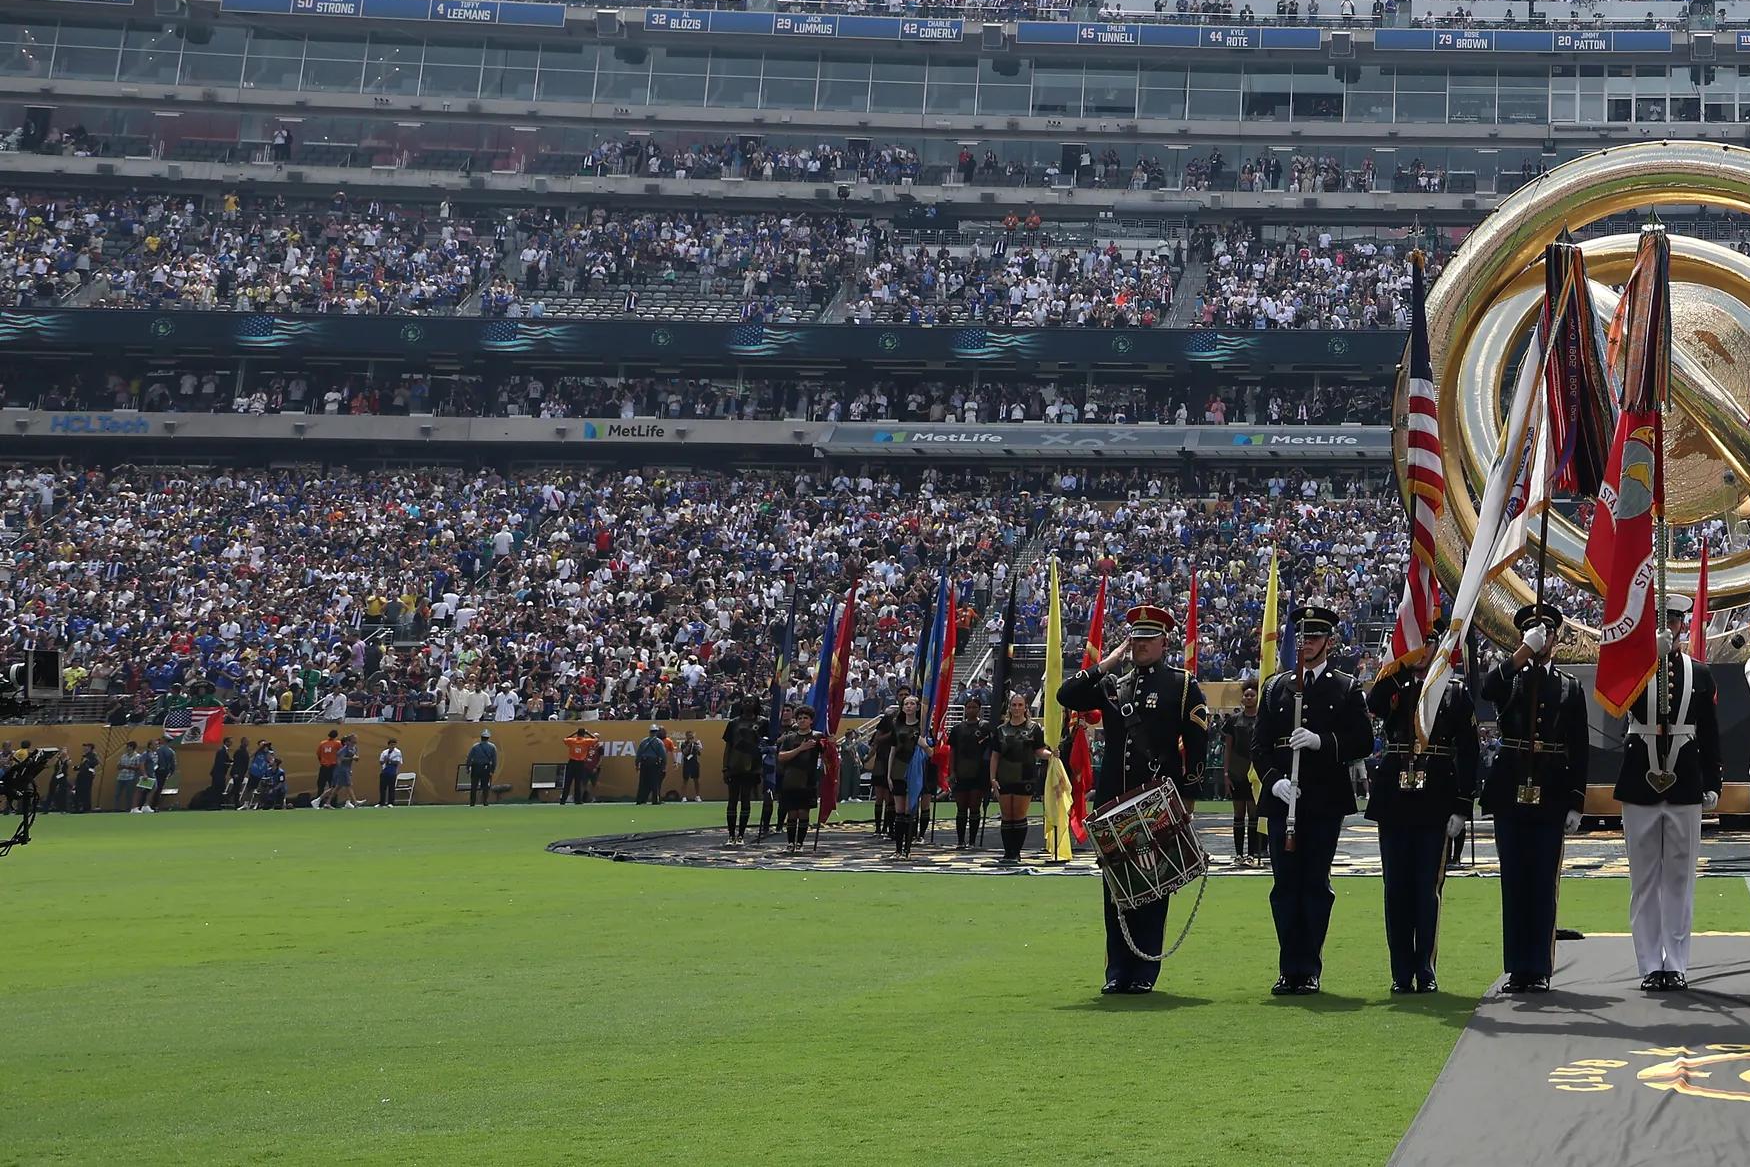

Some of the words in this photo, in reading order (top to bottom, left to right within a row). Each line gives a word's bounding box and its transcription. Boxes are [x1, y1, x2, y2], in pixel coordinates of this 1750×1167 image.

[316, 3, 355, 14] STRONG
[437, 4, 444, 14] 4
[460, 1, 480, 9] TUFFY
[447, 9, 491, 20] LEEMANS
[651, 14, 666, 25] 32
[806, 15, 822, 23] JACK
[669, 18, 702, 30] BLOZIS
[776, 18, 791, 29] 29
[793, 23, 833, 34] LUMMUS
[903, 23, 917, 34] 42
[926, 20, 952, 28] CHARLIE
[919, 28, 958, 39] CONERLY
[1080, 27, 1094, 38] 45
[1097, 32, 1135, 43] TUNNELL
[1209, 31, 1223, 42] 44
[1580, 32, 1600, 40] JIMMY
[1225, 36, 1249, 46] ROTE
[1438, 34, 1452, 45] 79
[1455, 38, 1488, 49] BROWN
[1557, 35, 1572, 46] 20
[1573, 39, 1607, 50] PATTON
[50, 416, 150, 434] HCLTech
[608, 425, 665, 437] MetLife
[912, 433, 1003, 442] MetLife
[1270, 435, 1358, 445] MetLife
[1602, 617, 1634, 642] ITED
[1635, 561, 1654, 589] STA
